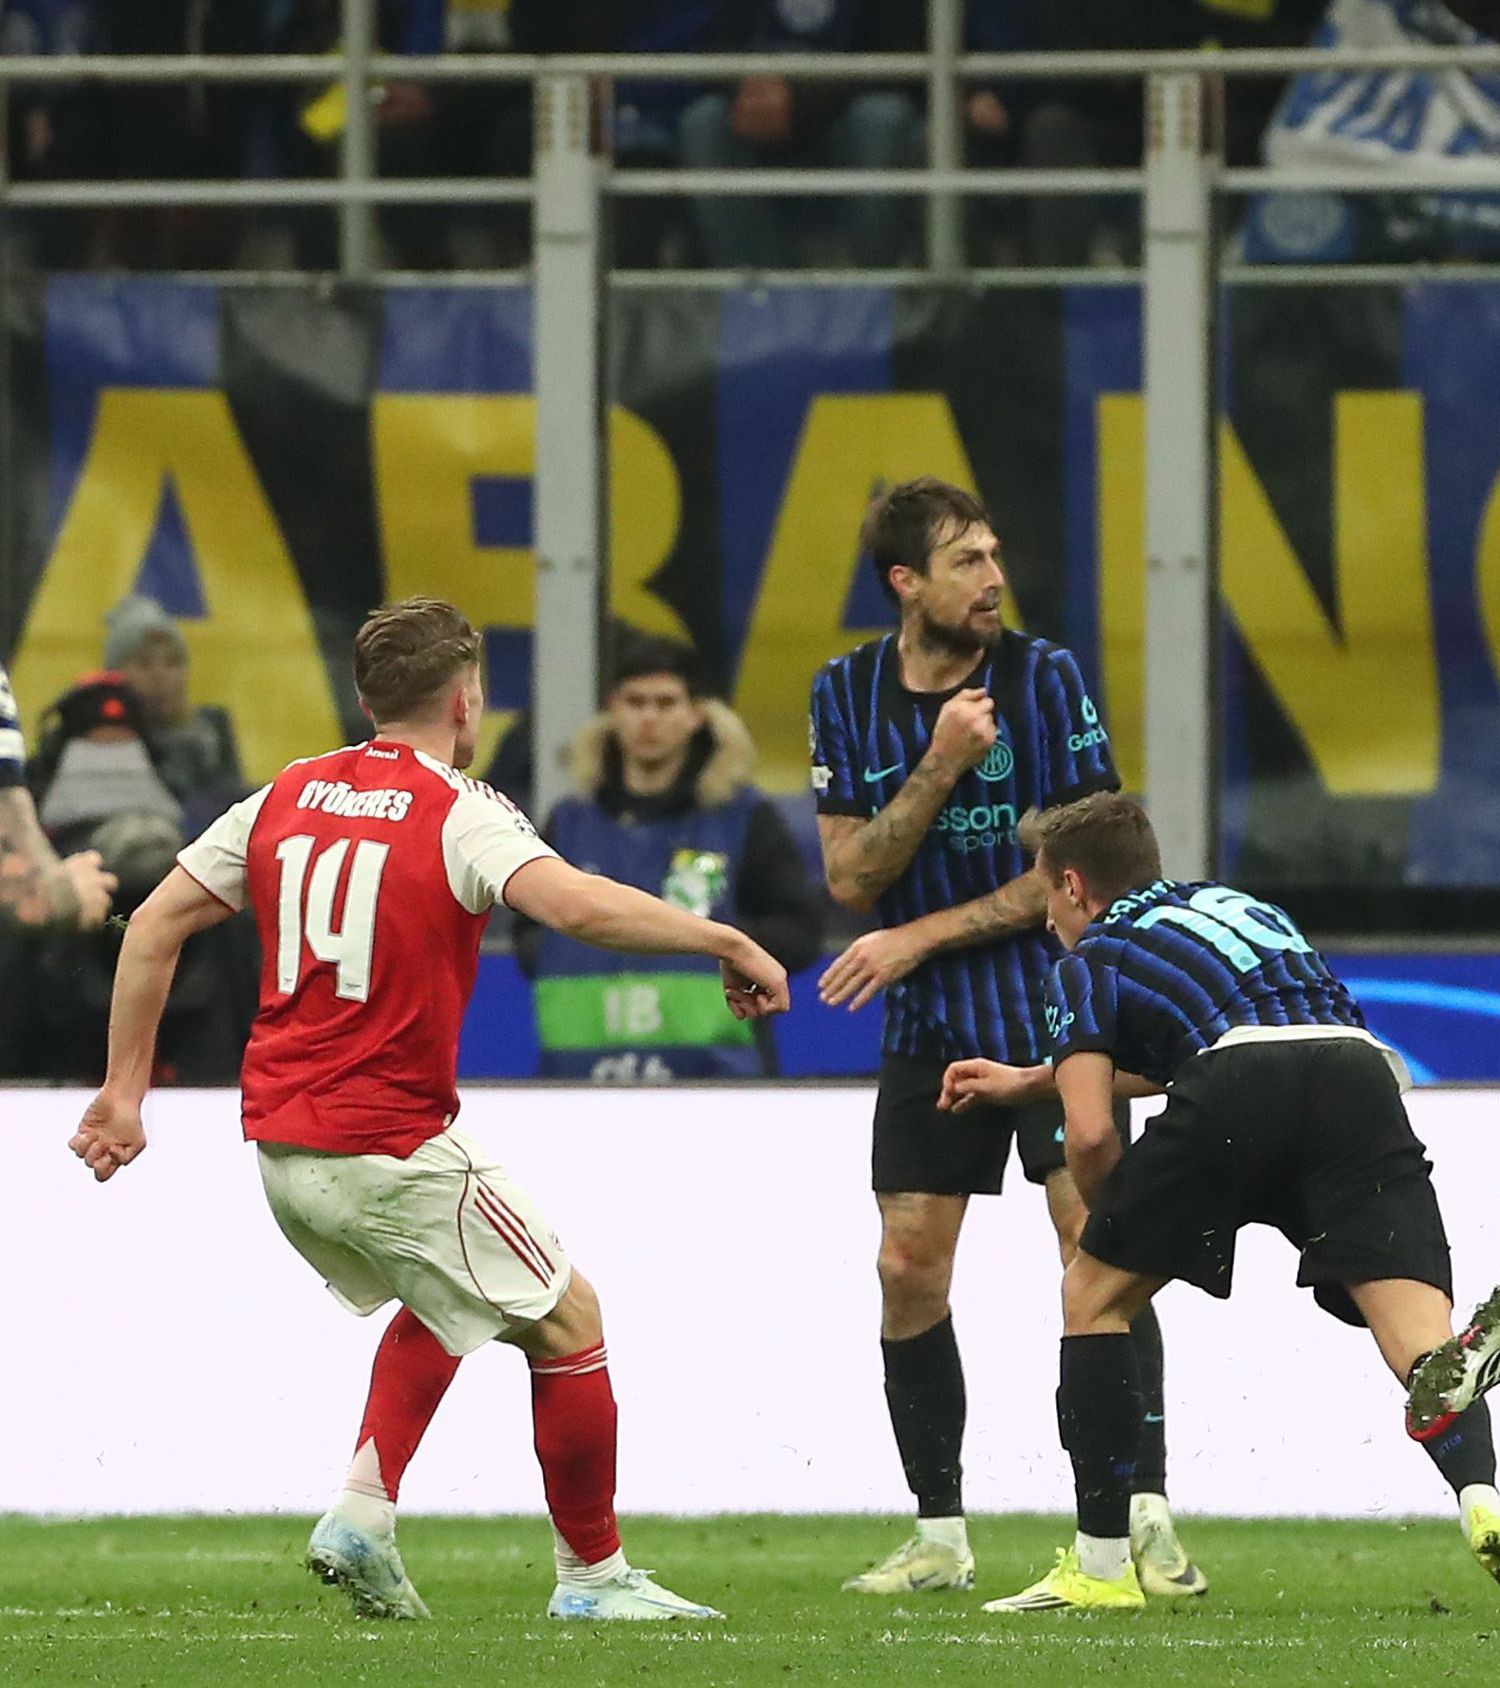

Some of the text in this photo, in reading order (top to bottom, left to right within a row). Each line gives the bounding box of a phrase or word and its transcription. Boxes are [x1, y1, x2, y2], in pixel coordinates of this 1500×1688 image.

[364, 746, 399, 760] Arsenal
[296, 779, 414, 822] GYÖKERES
[275, 834, 391, 1004] 14
[1132, 886, 1314, 974] 16
